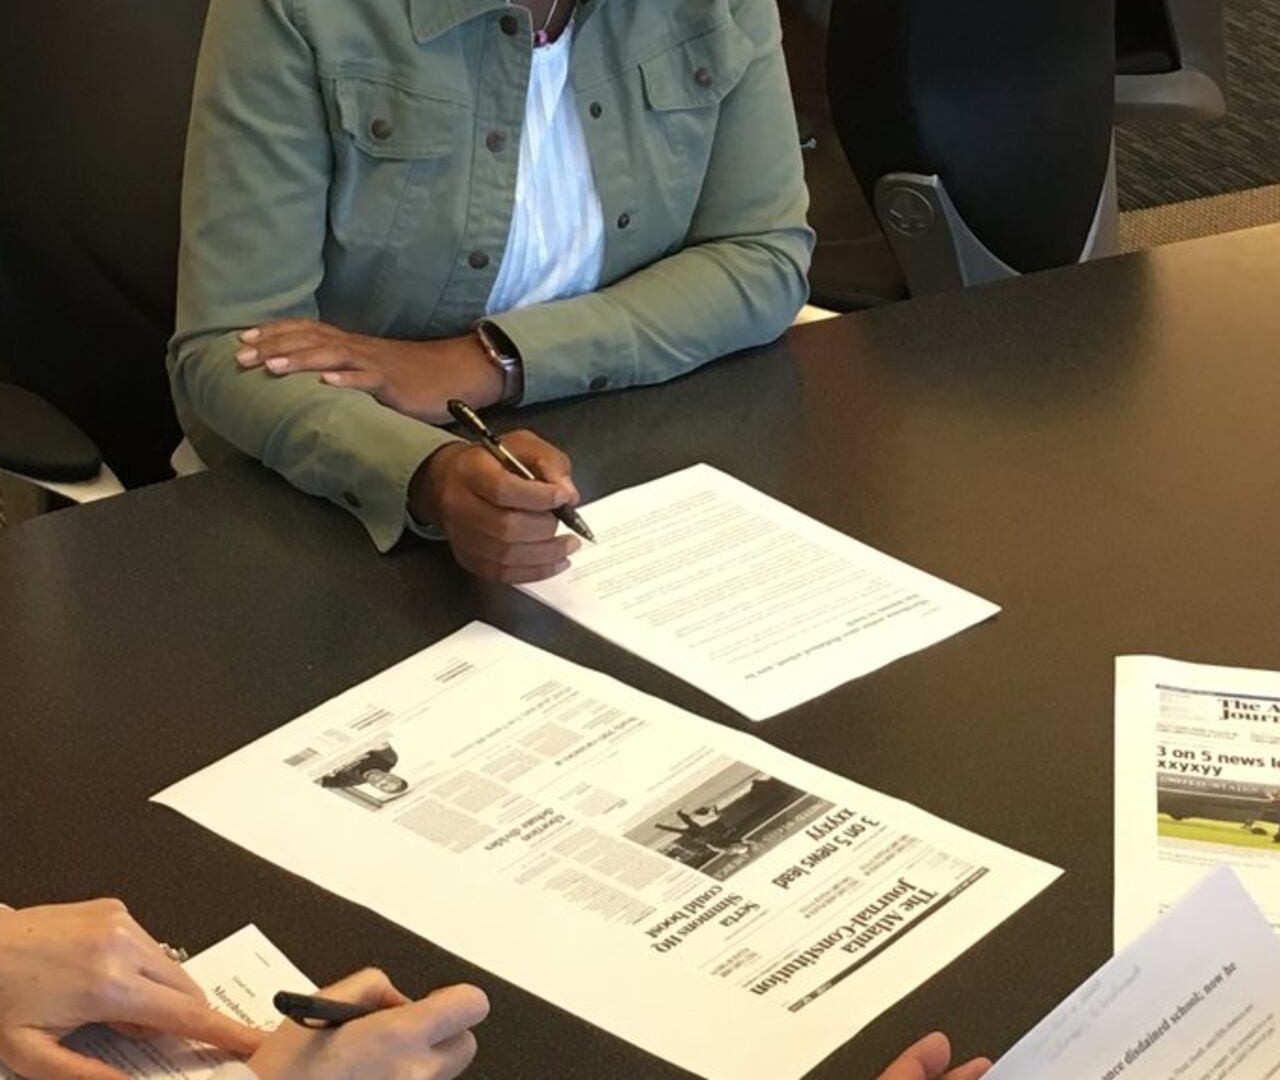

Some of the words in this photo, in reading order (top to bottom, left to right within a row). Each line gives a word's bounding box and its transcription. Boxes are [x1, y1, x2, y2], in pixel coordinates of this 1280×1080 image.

[1218, 697, 1261, 712] The
[1156, 745, 1167, 757] 3
[1172, 748, 1196, 760] on
[1201, 750, 1213, 762] 5
[1218, 753, 1266, 768] news
[800, 843, 839, 868] news
[772, 866, 810, 889] lead
[899, 889, 938, 911] The
[719, 903, 760, 927] Serta
[750, 877, 917, 995] Journal-Constitution
[841, 911, 904, 953] Atlanta
[1123, 1017, 1171, 1065] disdained
[1203, 972, 1224, 995] now
[1222, 961, 1238, 977] he
